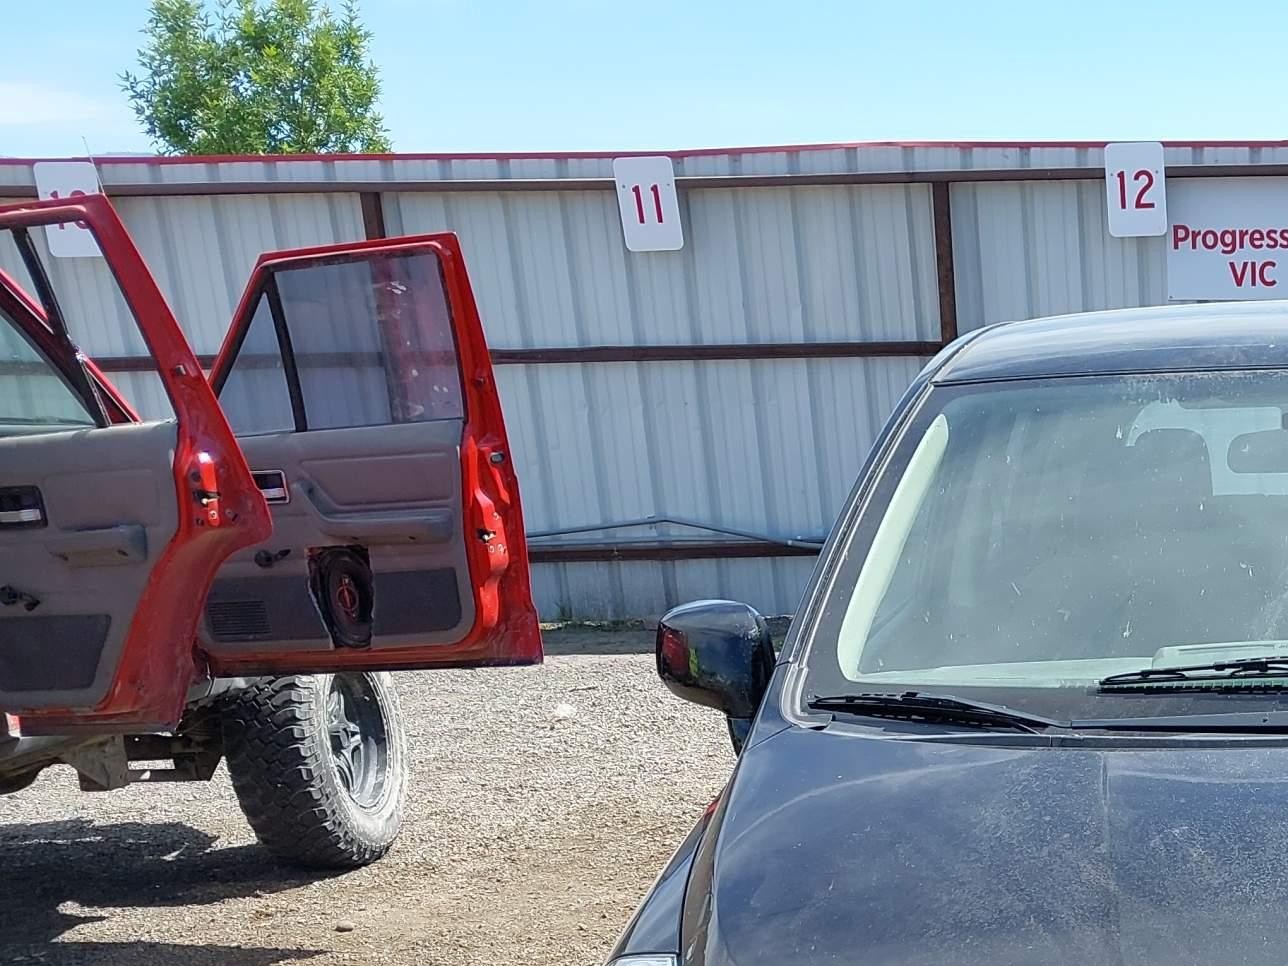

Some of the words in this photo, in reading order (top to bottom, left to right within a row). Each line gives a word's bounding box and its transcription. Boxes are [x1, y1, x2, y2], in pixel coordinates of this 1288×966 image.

[632, 184, 663, 224] 11
[1117, 170, 1155, 209] 12
[1229, 261, 1277, 287] VIC
